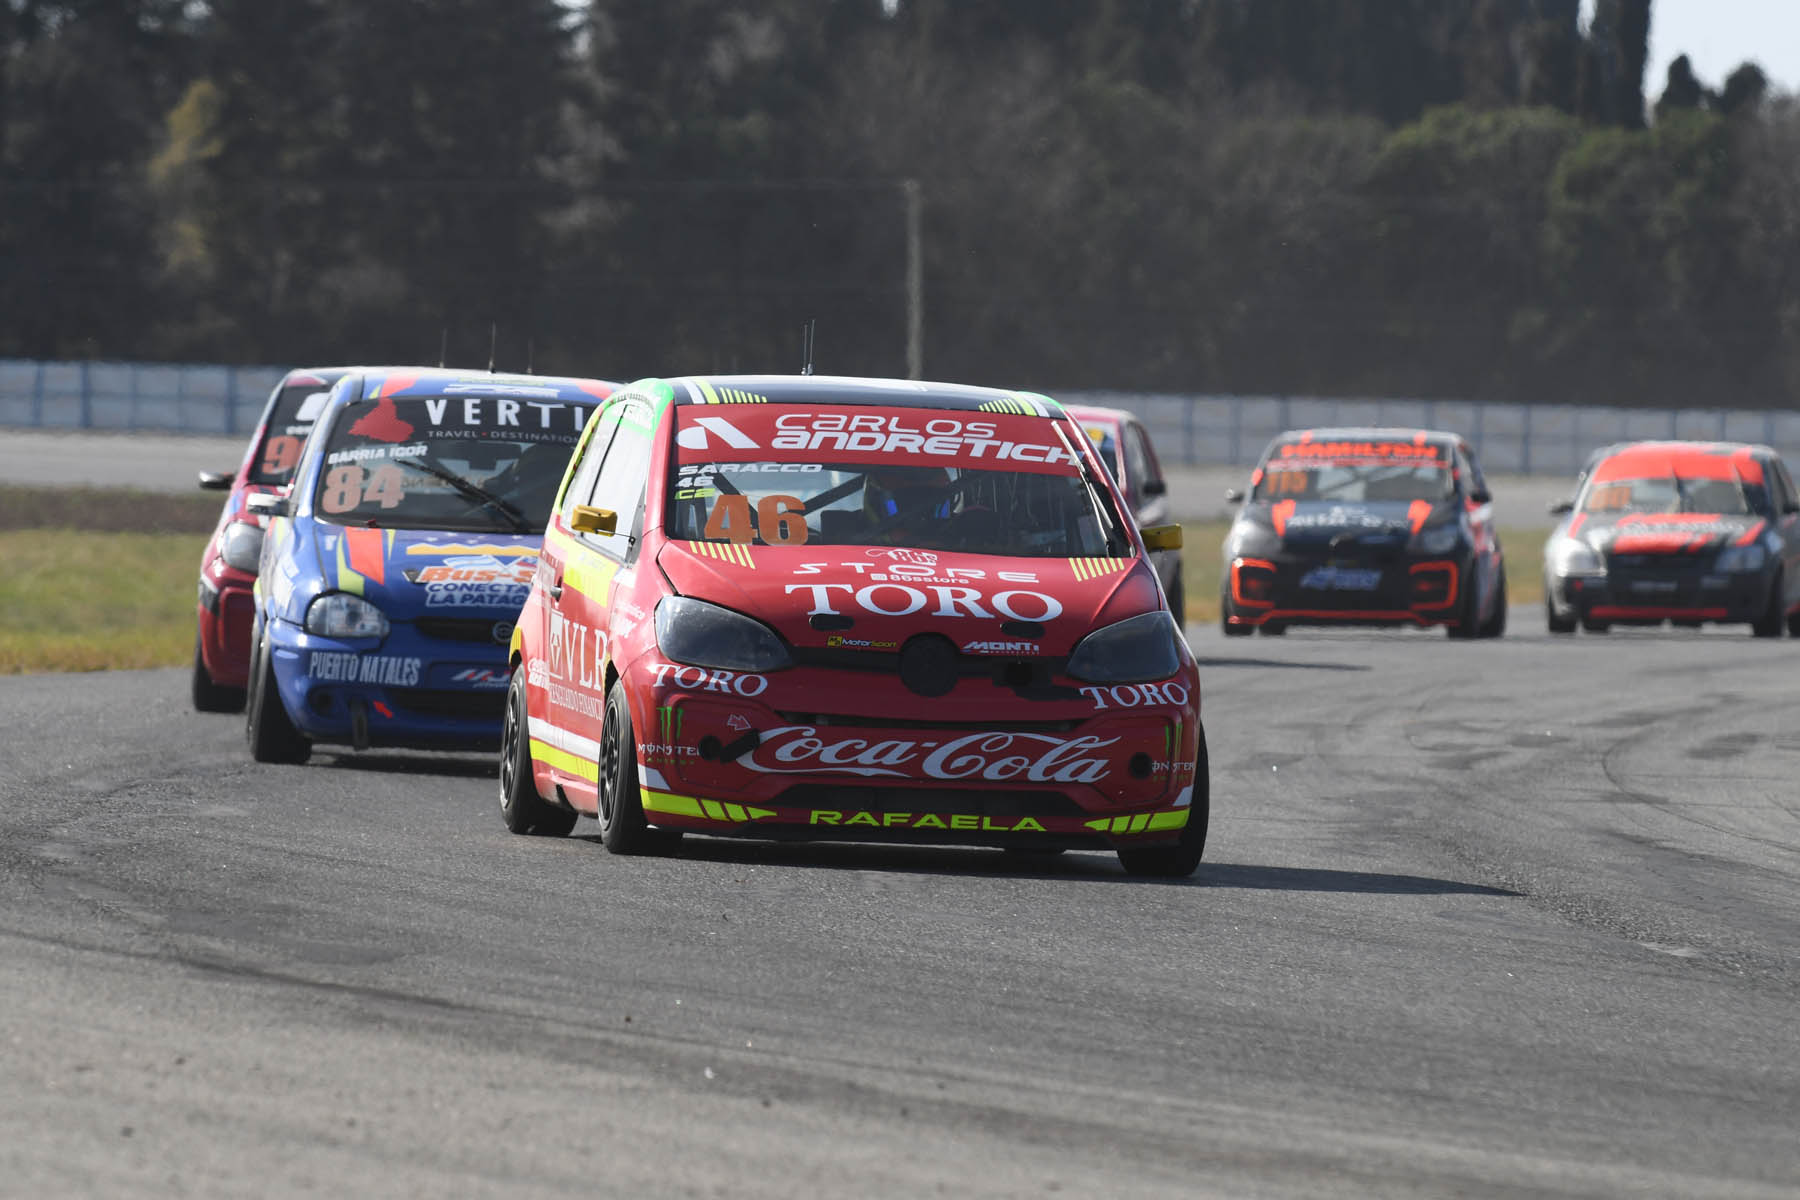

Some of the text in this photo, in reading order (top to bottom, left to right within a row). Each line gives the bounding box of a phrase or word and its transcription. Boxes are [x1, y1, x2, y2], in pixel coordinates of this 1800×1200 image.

[427, 429, 478, 439] TRAVEL
[775, 412, 997, 438] CARLOS
[262, 435, 304, 475] 9
[678, 463, 823, 476] SARACCO
[322, 464, 405, 514] 84
[704, 494, 809, 546] 46
[793, 561, 1040, 583] STORE
[428, 583, 529, 593] CONECTA
[428, 593, 457, 605] LA
[785, 584, 1063, 623] TORO
[308, 652, 357, 682] PUERTO
[360, 656, 421, 686] NATALES
[650, 663, 768, 697] TORO
[1079, 682, 1188, 709] TORO
[736, 725, 1122, 784] Coca-Cola
[810, 810, 1048, 832] RAFAELA
